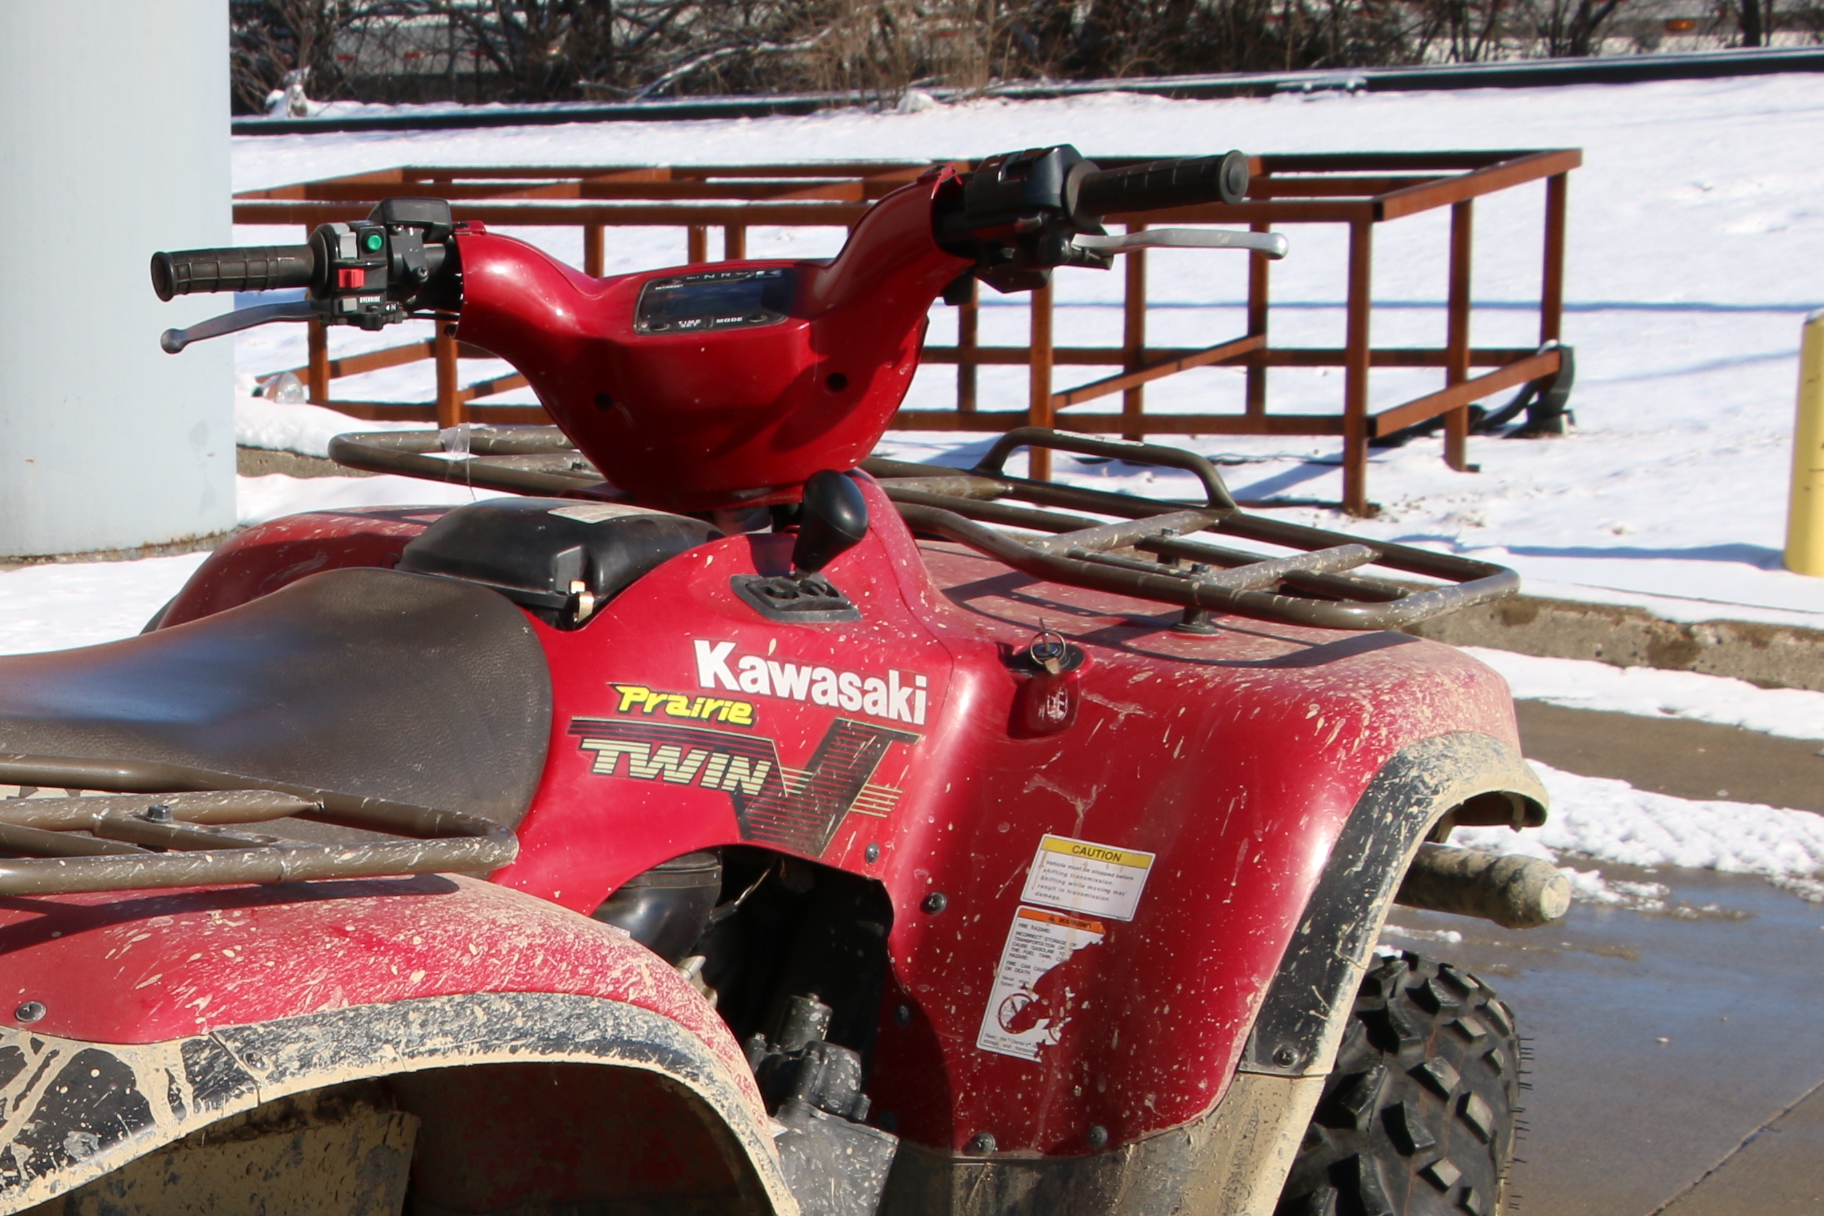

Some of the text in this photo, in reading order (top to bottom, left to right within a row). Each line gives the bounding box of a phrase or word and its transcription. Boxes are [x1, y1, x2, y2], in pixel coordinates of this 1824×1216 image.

[692, 639, 927, 725] Kawasaki
[613, 685, 753, 726] Prairie
[581, 738, 772, 796] TWIN
[1072, 845, 1122, 862] CAUTION
[1043, 868, 1068, 878] shifting
[1046, 860, 1066, 868] Vehicle
[1068, 864, 1082, 872] must
[1092, 868, 1115, 878] stopped
[1116, 872, 1134, 880] before
[1040, 876, 1066, 886] Shifting
[1068, 880, 1086, 888] while
[1087, 884, 1111, 894] moving
[1066, 888, 1110, 901] transmission
[1058, 917, 1092, 930] WARNING
[1014, 936, 1055, 948] TRANSPORTATION
[1016, 931, 1042, 940] INCORRECT
[1044, 937, 1066, 946] STORAGE
[1031, 946, 1054, 954] GASOLINE
